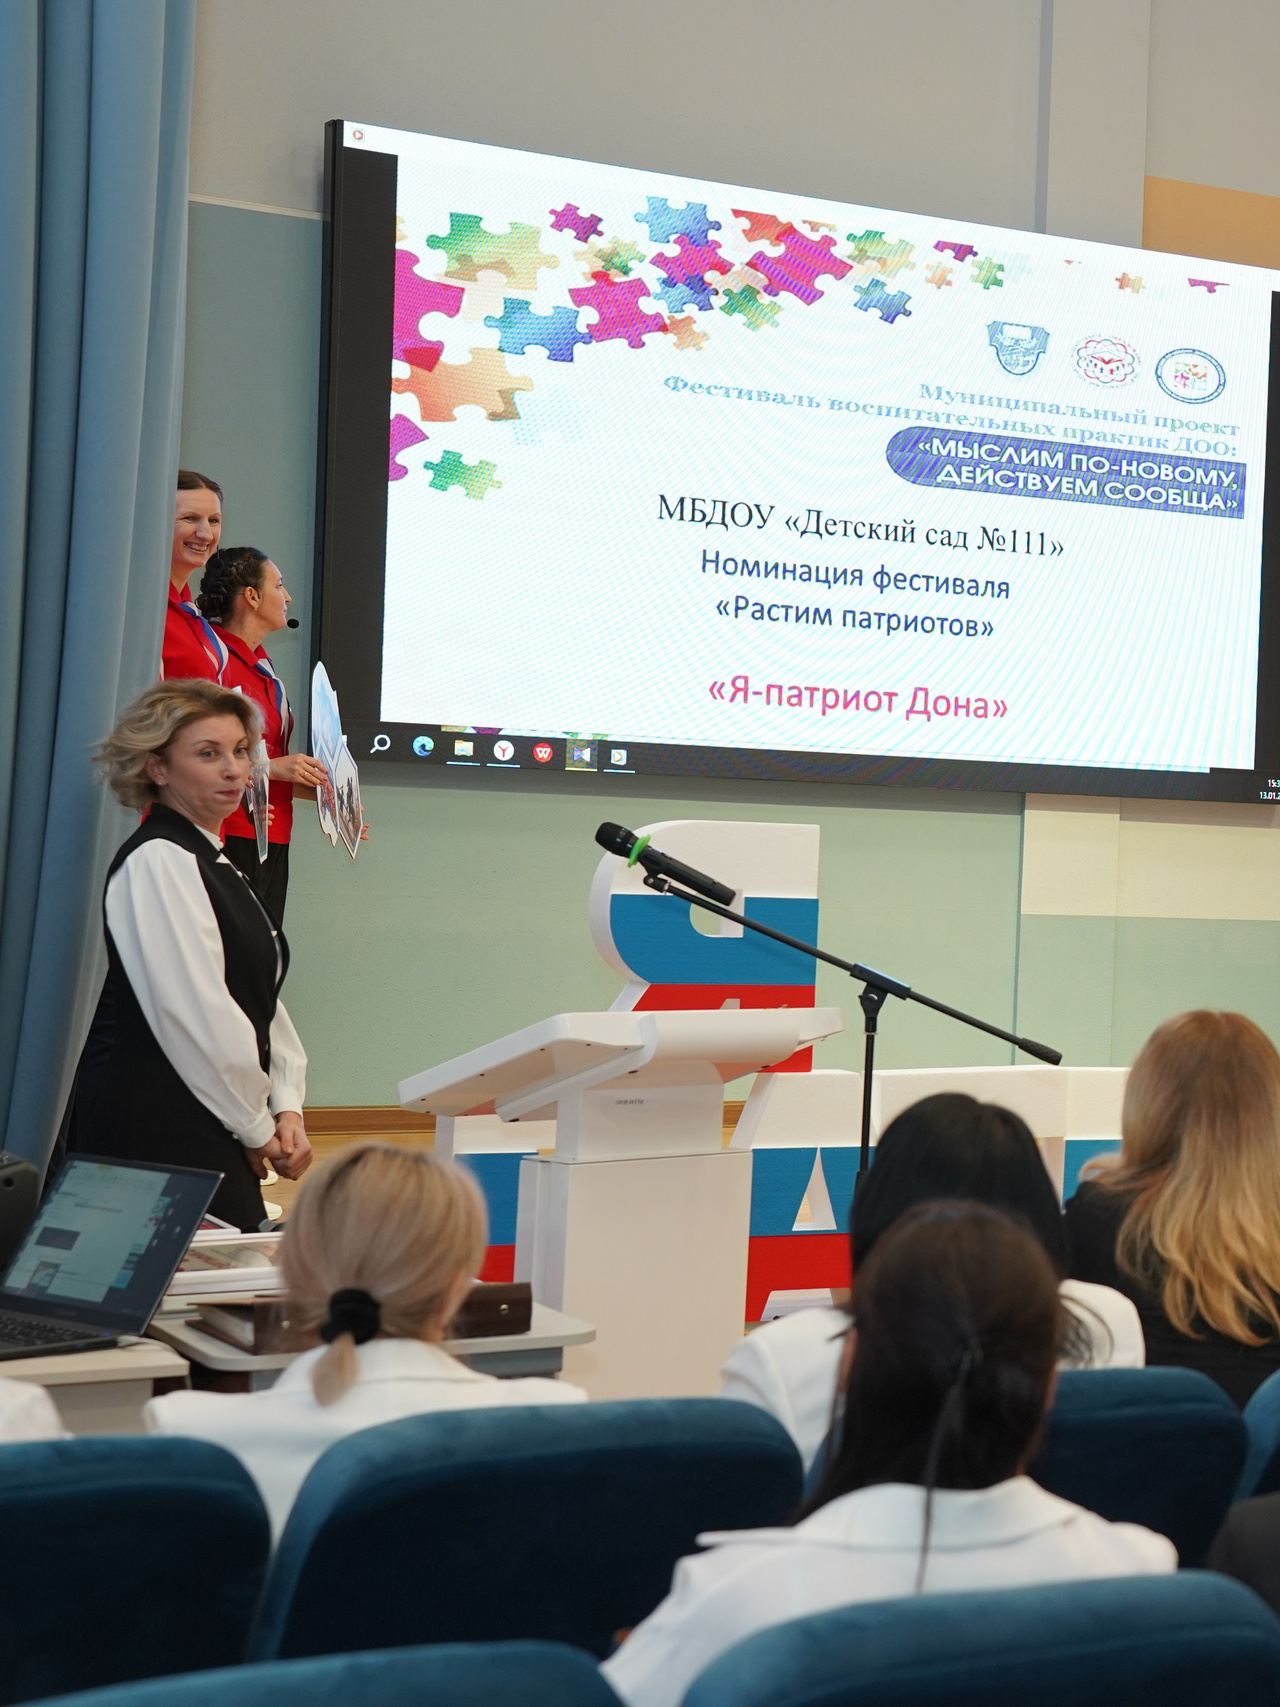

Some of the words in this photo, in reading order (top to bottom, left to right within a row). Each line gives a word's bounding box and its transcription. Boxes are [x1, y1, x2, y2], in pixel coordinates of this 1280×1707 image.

[663, 375, 821, 409] Фестиваль
[828, 398, 1056, 437] воспитательных
[1062, 427, 1169, 450] практик
[1173, 437, 1237, 457] ДОО:
[918, 384, 1148, 425] Муниципальный
[1154, 406, 1240, 436] проект
[918, 438, 1064, 470] «МЫСЛИМ
[1071, 454, 1238, 490] ПО-НОВОМУ,
[936, 464, 1098, 497] ДЕЙСТВУЕМ
[1104, 481, 1238, 511] СООБЩА»
[658, 494, 775, 531] МБДОУ
[785, 509, 916, 544] «Детский
[926, 527, 969, 551] сад
[977, 526, 1064, 557] №111»
[702, 549, 863, 589] Номинация
[873, 564, 1010, 599] фестиваля
[716, 595, 833, 626] «Растим
[842, 609, 994, 637] патриотов»
[709, 675, 898, 716] «Я-патриот
[906, 687, 1008, 722] Дона»
